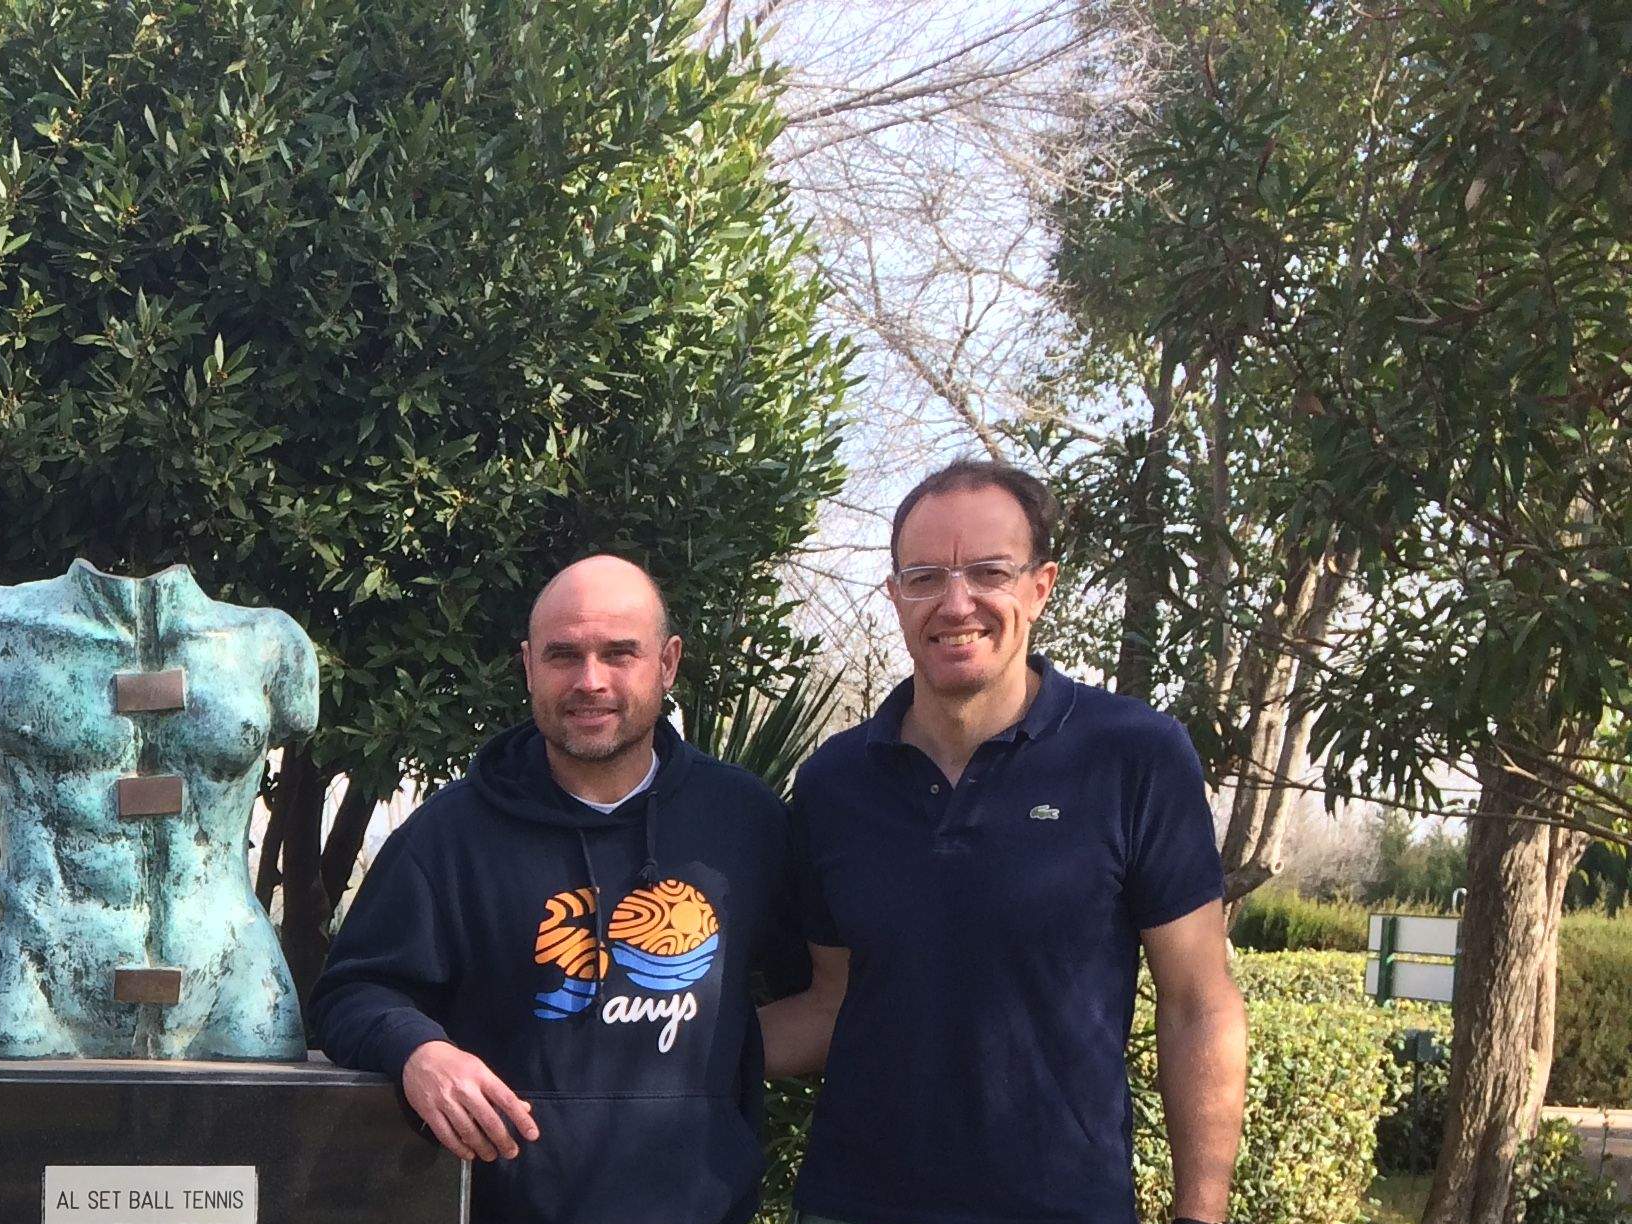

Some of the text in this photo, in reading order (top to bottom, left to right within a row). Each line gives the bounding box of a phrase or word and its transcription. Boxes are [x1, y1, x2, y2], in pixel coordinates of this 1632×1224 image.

[602, 992, 698, 1053] anys
[56, 1190, 244, 1210] AL SET BALL TENNIS
